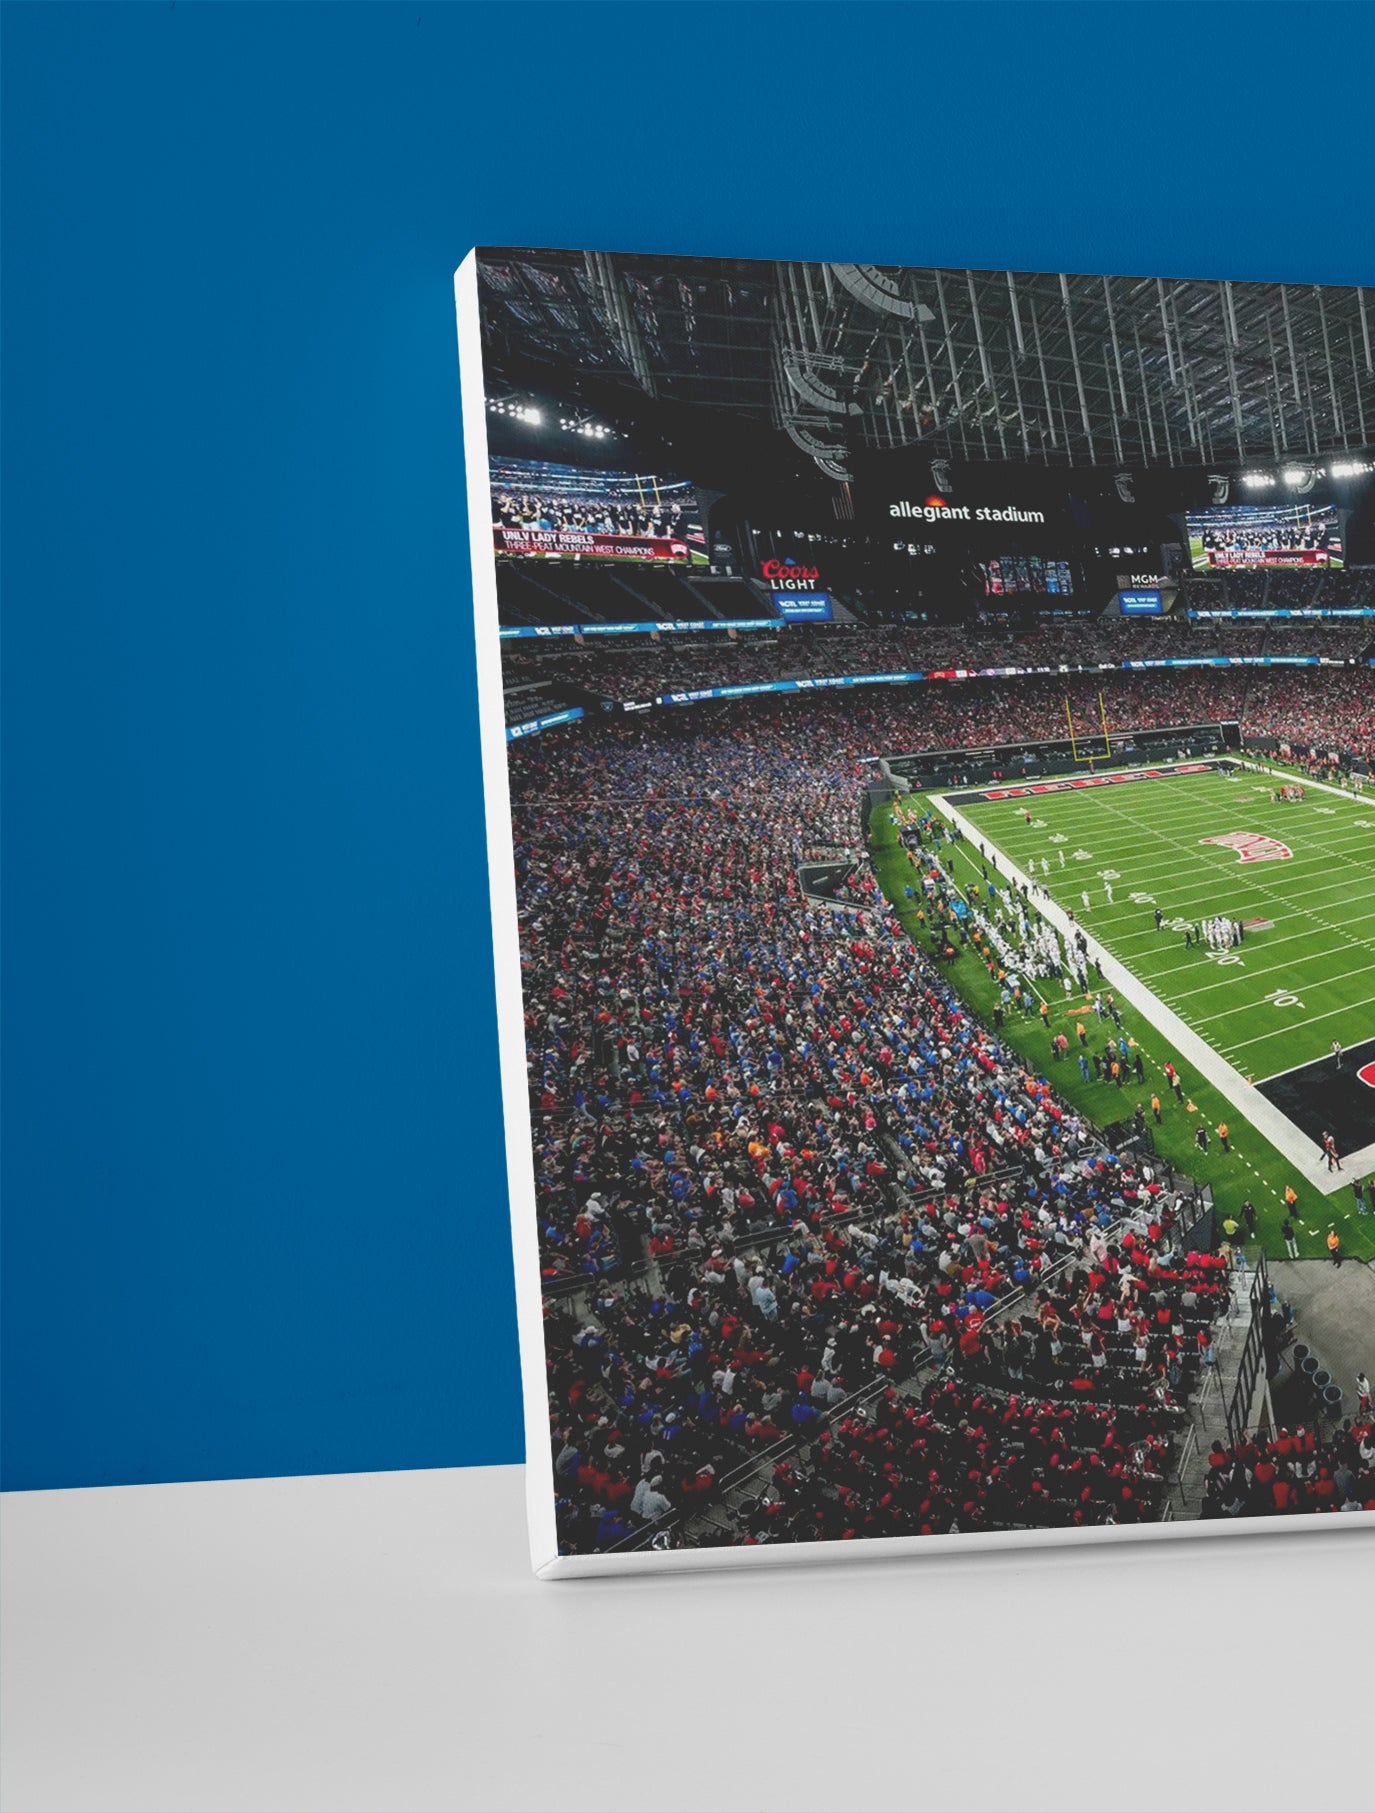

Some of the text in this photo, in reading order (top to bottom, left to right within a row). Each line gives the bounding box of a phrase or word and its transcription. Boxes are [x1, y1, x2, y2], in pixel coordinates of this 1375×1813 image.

[889, 501, 1044, 523] allegiant stadium
[502, 531, 594, 545] UNLV LADY REBELS
[504, 540, 655, 556] THREE-PEAT MOUNTAIN WEST CHAMPIONS
[760, 559, 819, 579] Coors
[771, 579, 816, 590] LIGHT
[1131, 575, 1158, 584] MGM
[1205, 947, 1240, 965] 20
[1264, 989, 1299, 1007] 10
